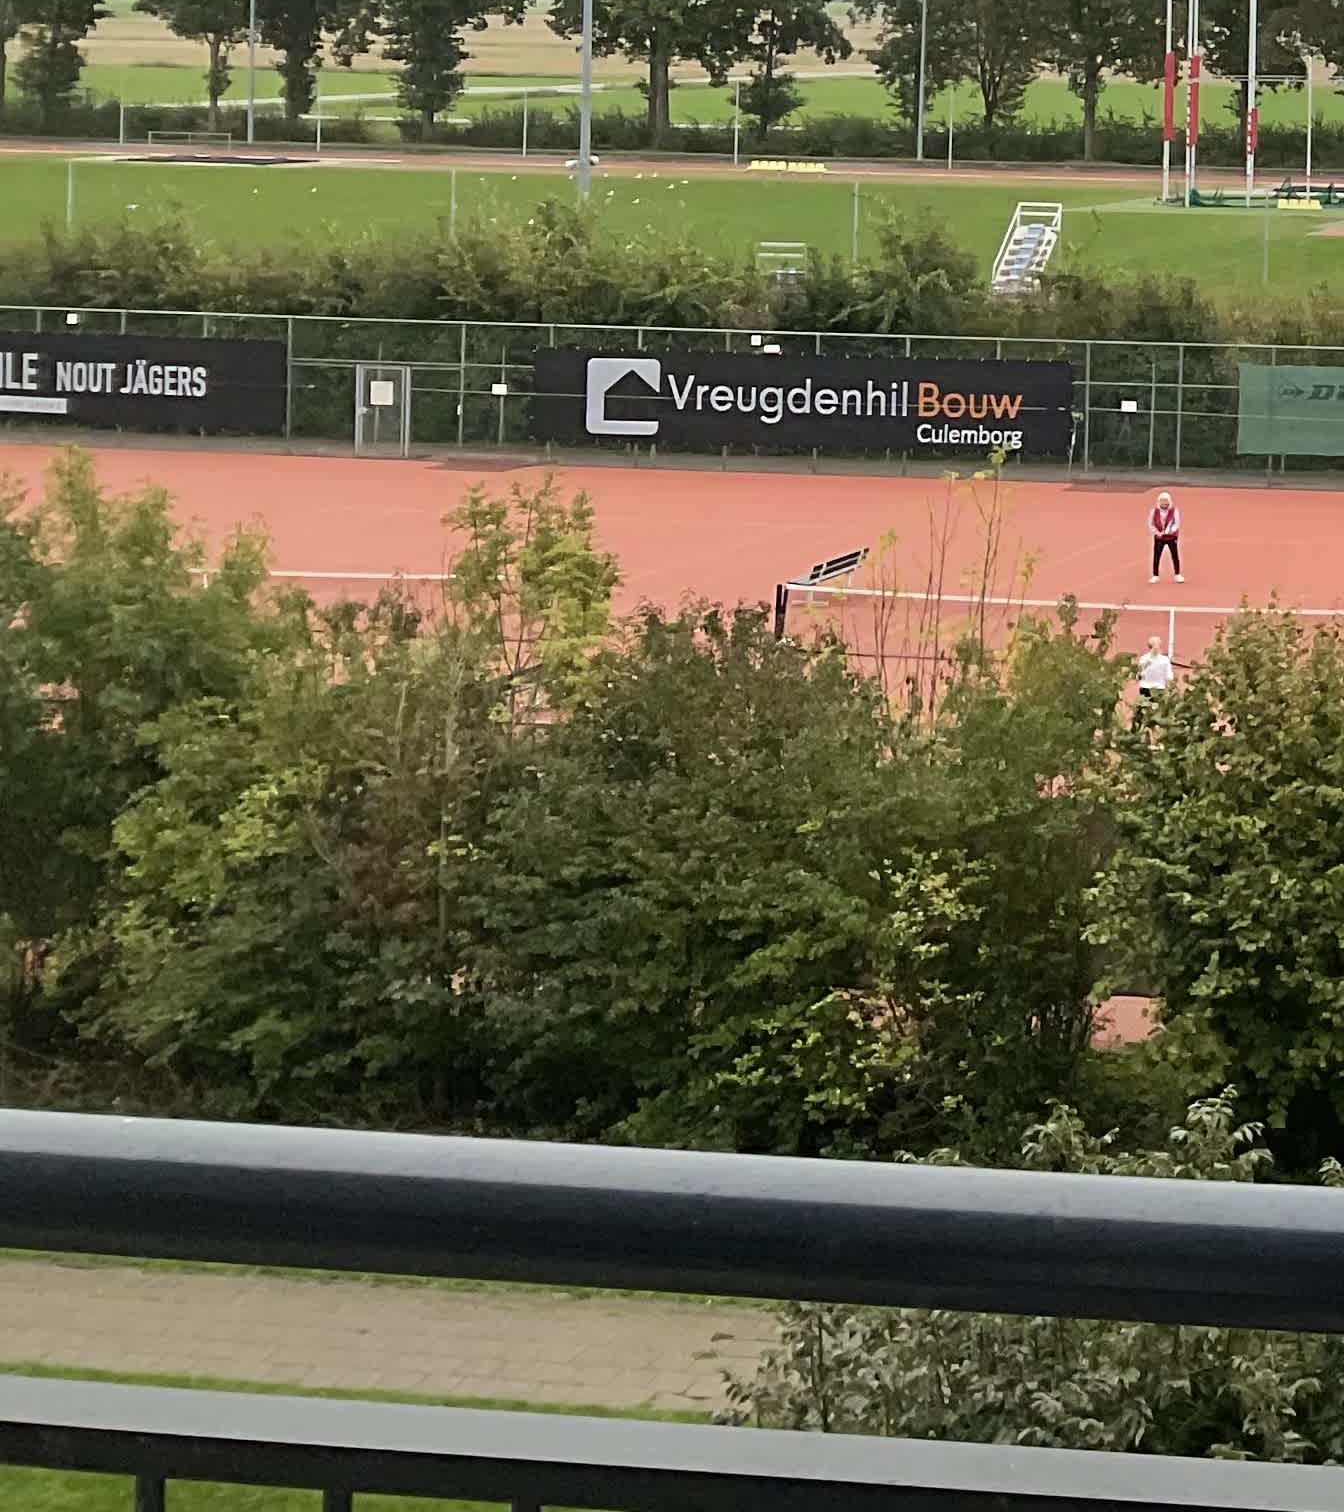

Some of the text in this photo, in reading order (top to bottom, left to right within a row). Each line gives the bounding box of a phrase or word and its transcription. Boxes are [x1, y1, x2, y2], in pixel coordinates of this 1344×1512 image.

[56, 359, 207, 397] NOUT JÄGERS
[916, 424, 1023, 448] Culemborg
